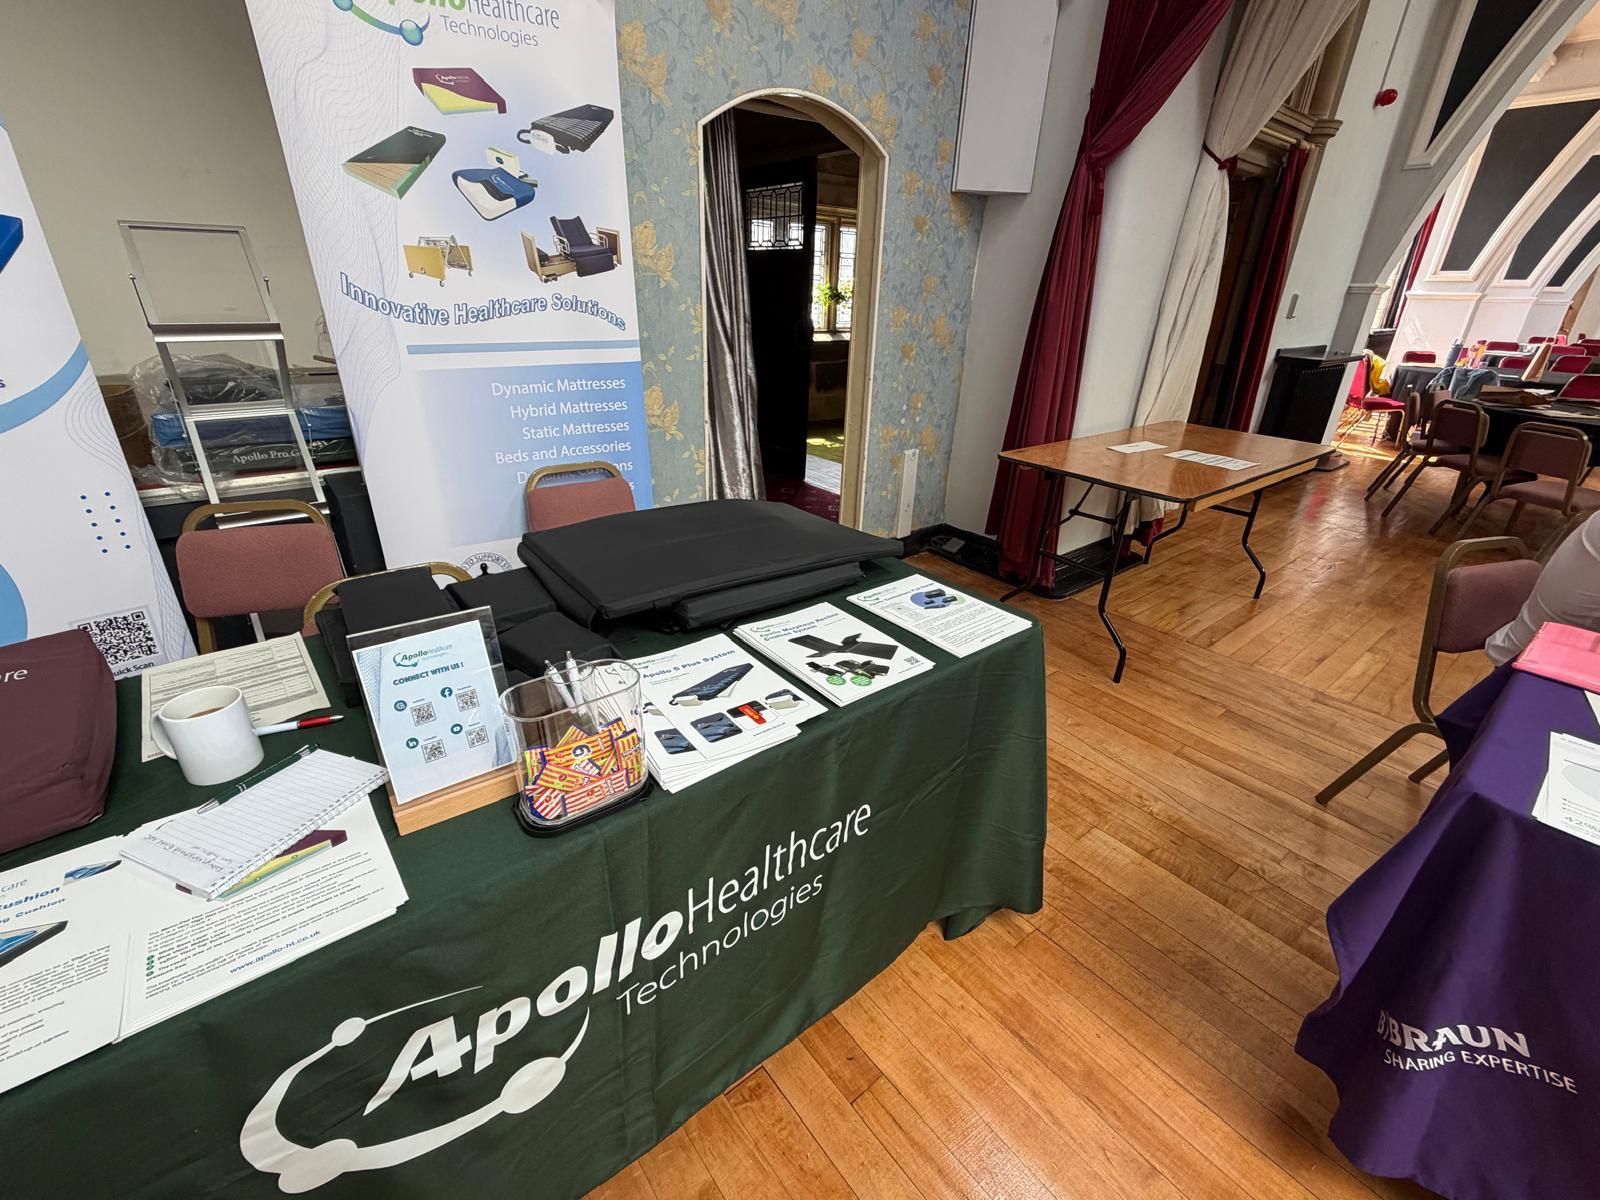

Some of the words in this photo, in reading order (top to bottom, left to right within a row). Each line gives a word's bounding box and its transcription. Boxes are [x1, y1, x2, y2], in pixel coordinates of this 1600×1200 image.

[440, 15, 539, 48] Technologies
[340, 272, 450, 325] Innovative
[454, 295, 548, 325] Healthcare
[551, 292, 626, 331] Solutions
[491, 380, 554, 399] Dynamic
[557, 377, 626, 392] Mattresses
[511, 403, 557, 421] Hybrid
[560, 400, 628, 415] Mattresses
[522, 425, 560, 440] Static
[563, 421, 630, 436] Mattresses
[232, 451, 268, 464] Apollo
[269, 450, 289, 459] Pro
[496, 449, 529, 465] Beds
[532, 447, 558, 461] and
[561, 441, 632, 457] Accessories
[401, 649, 428, 663] Apollo
[643, 668, 672, 680] Apollo
[681, 660, 701, 671] Plus
[702, 649, 736, 664] System
[113, 666, 133, 677] uick
[133, 661, 155, 671] Scan
[392, 671, 430, 686] CONNECT
[431, 665, 451, 677] WITH
[451, 663, 460, 674] US
[16, 897, 66, 918] Cushion
[230, 929, 321, 974] www.apollo-ht.co.uk
[616, 873, 824, 1016] Technologies
[362, 909, 684, 1116] Apollo
[686, 803, 872, 936] Healthcare
[1383, 1049, 1456, 1072] SHARING
[1460, 1051, 1578, 1094] EXPERTISE
